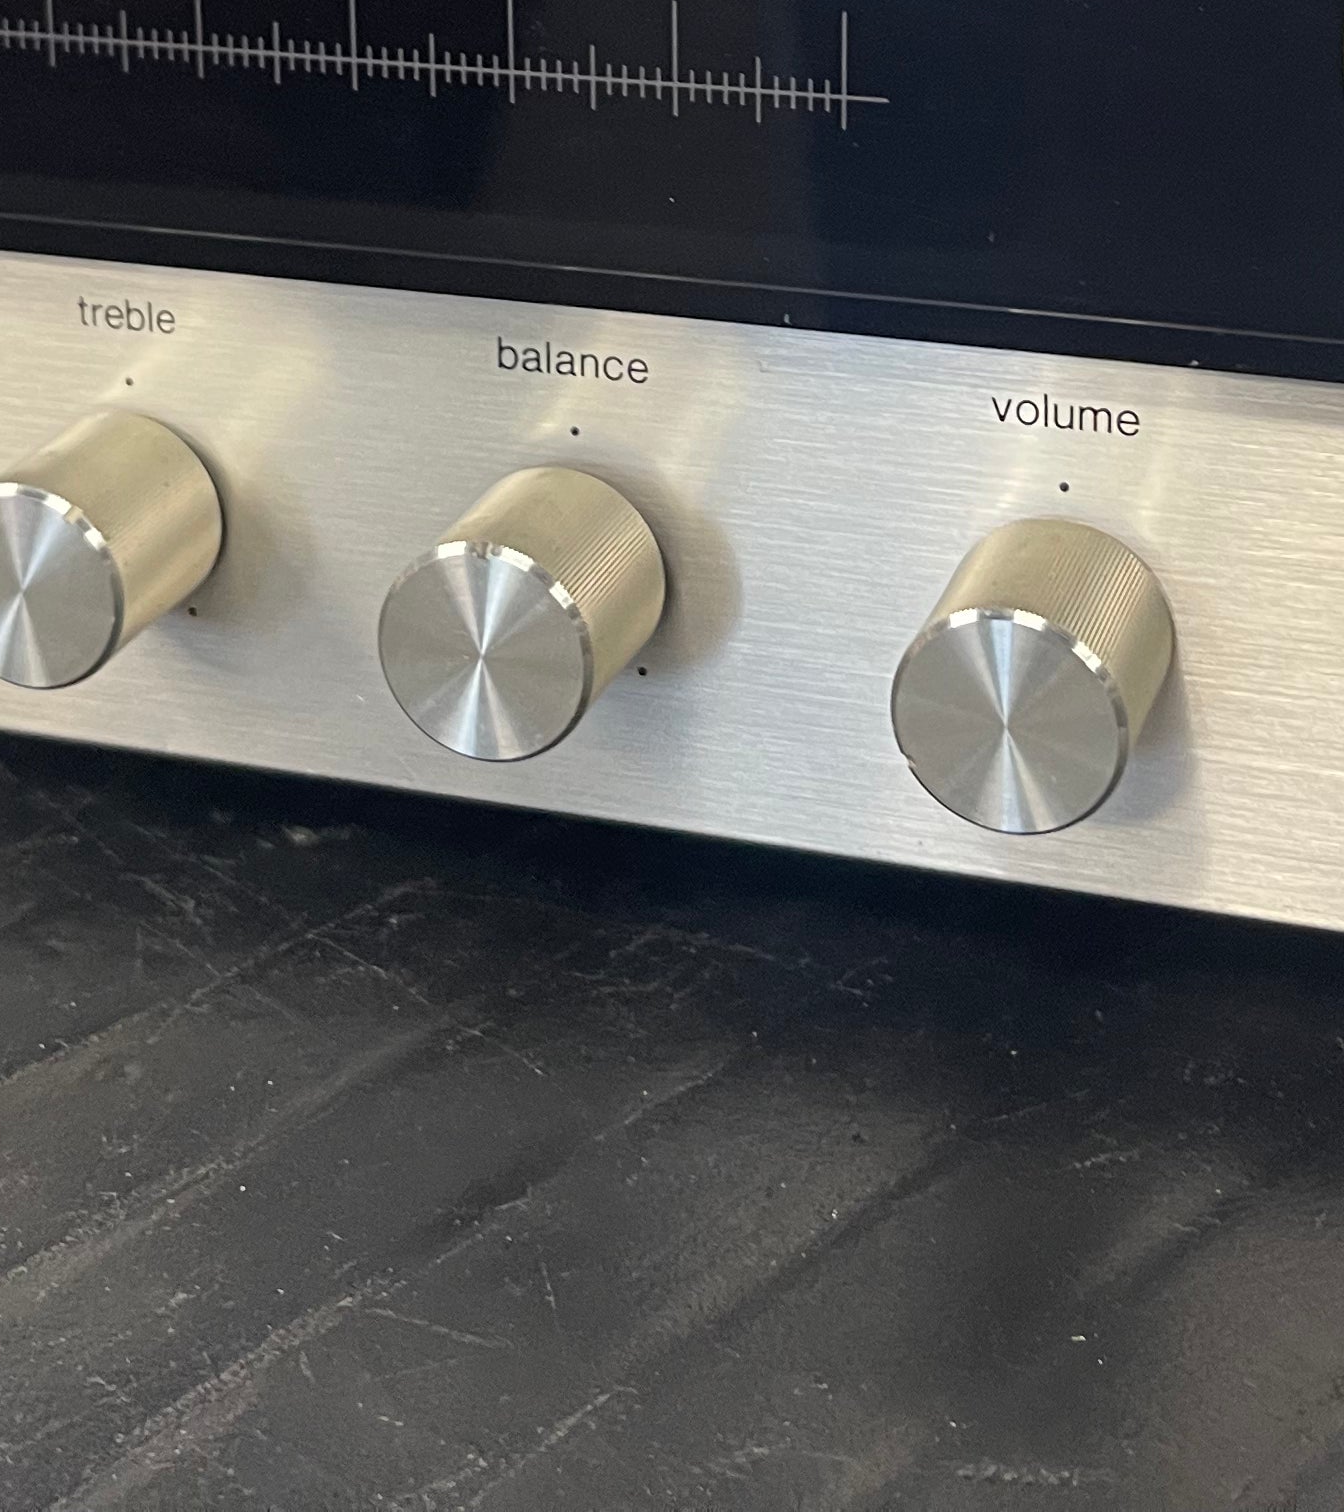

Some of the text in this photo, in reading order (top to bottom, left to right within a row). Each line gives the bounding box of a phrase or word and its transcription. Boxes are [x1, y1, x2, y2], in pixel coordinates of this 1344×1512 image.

[77, 295, 177, 335] treble
[497, 336, 650, 385] balance
[990, 394, 1141, 438] volume
